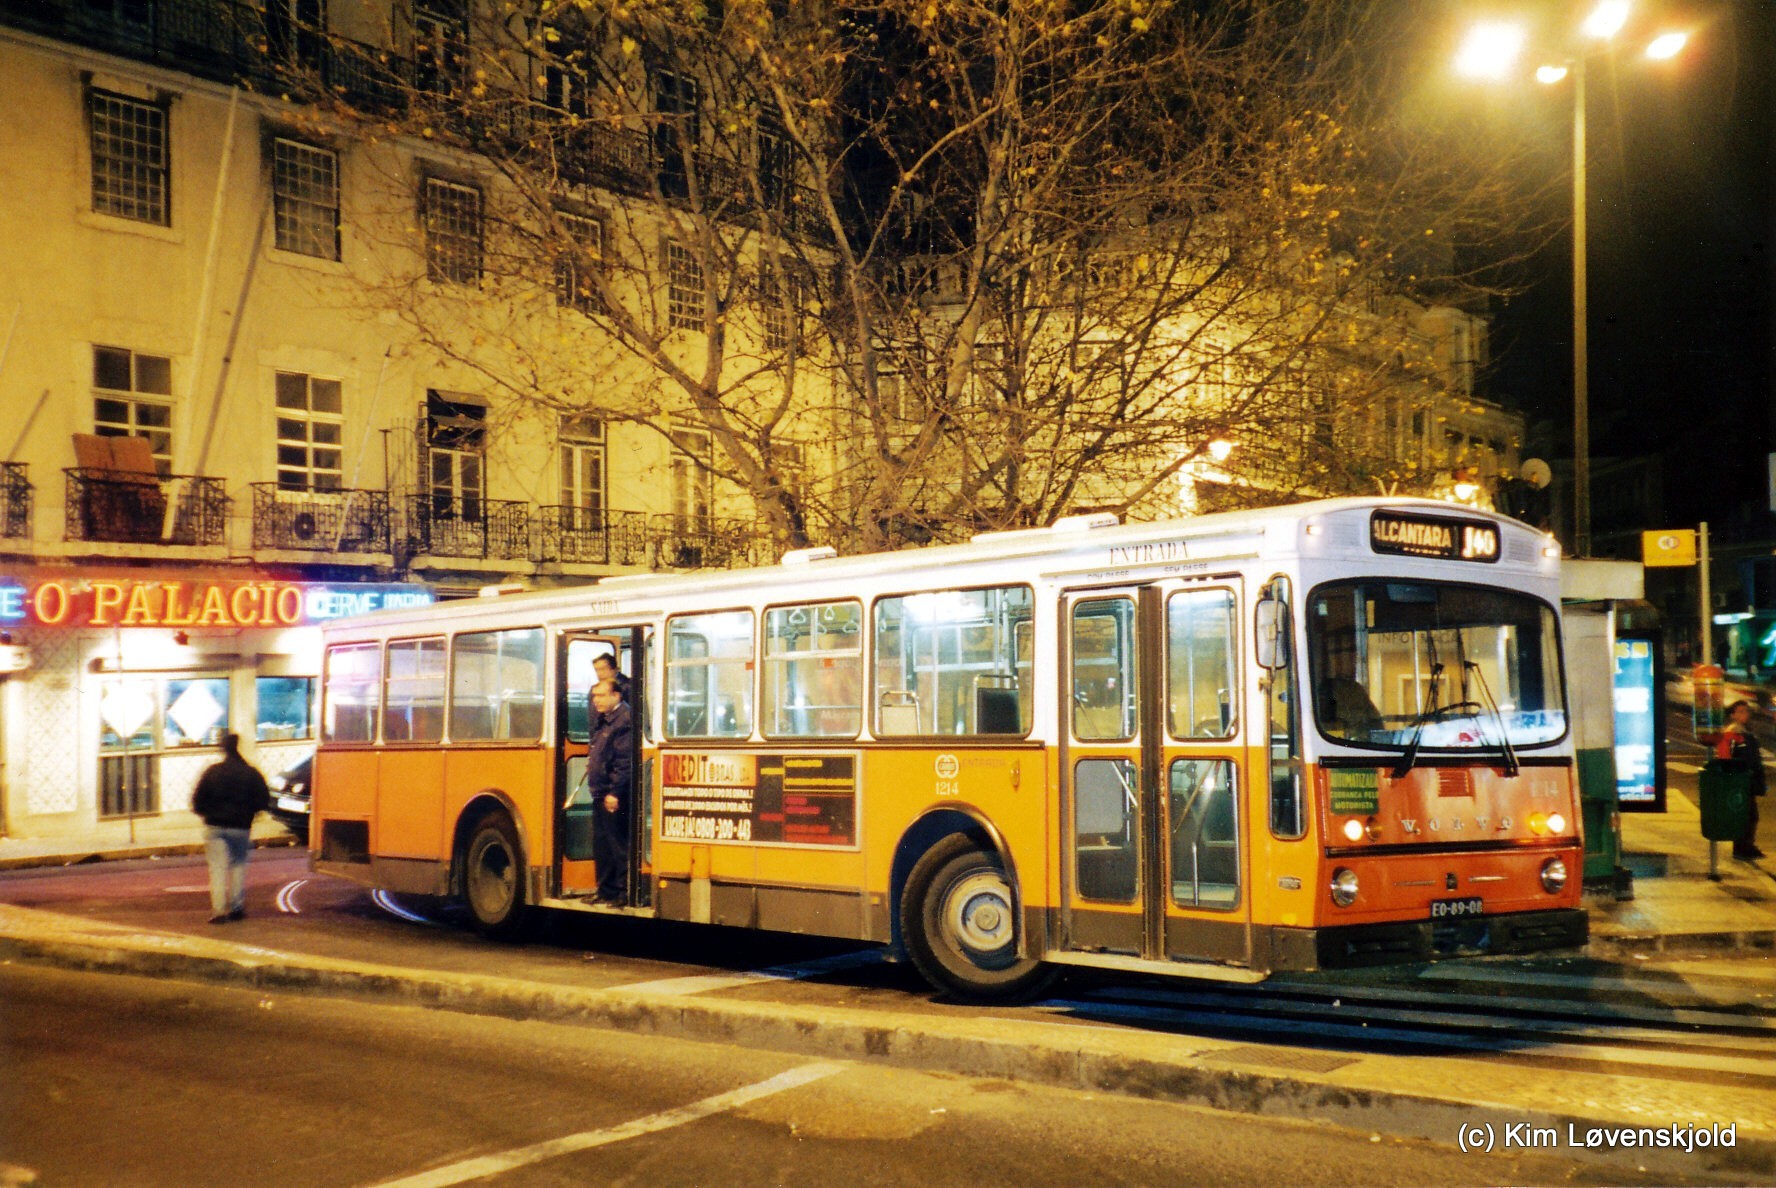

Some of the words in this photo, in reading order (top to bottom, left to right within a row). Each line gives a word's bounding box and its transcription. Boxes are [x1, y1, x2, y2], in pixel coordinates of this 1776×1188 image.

[35, 583, 68, 624] O
[88, 583, 302, 626] PALACIO
[935, 781, 959, 796] 1214
